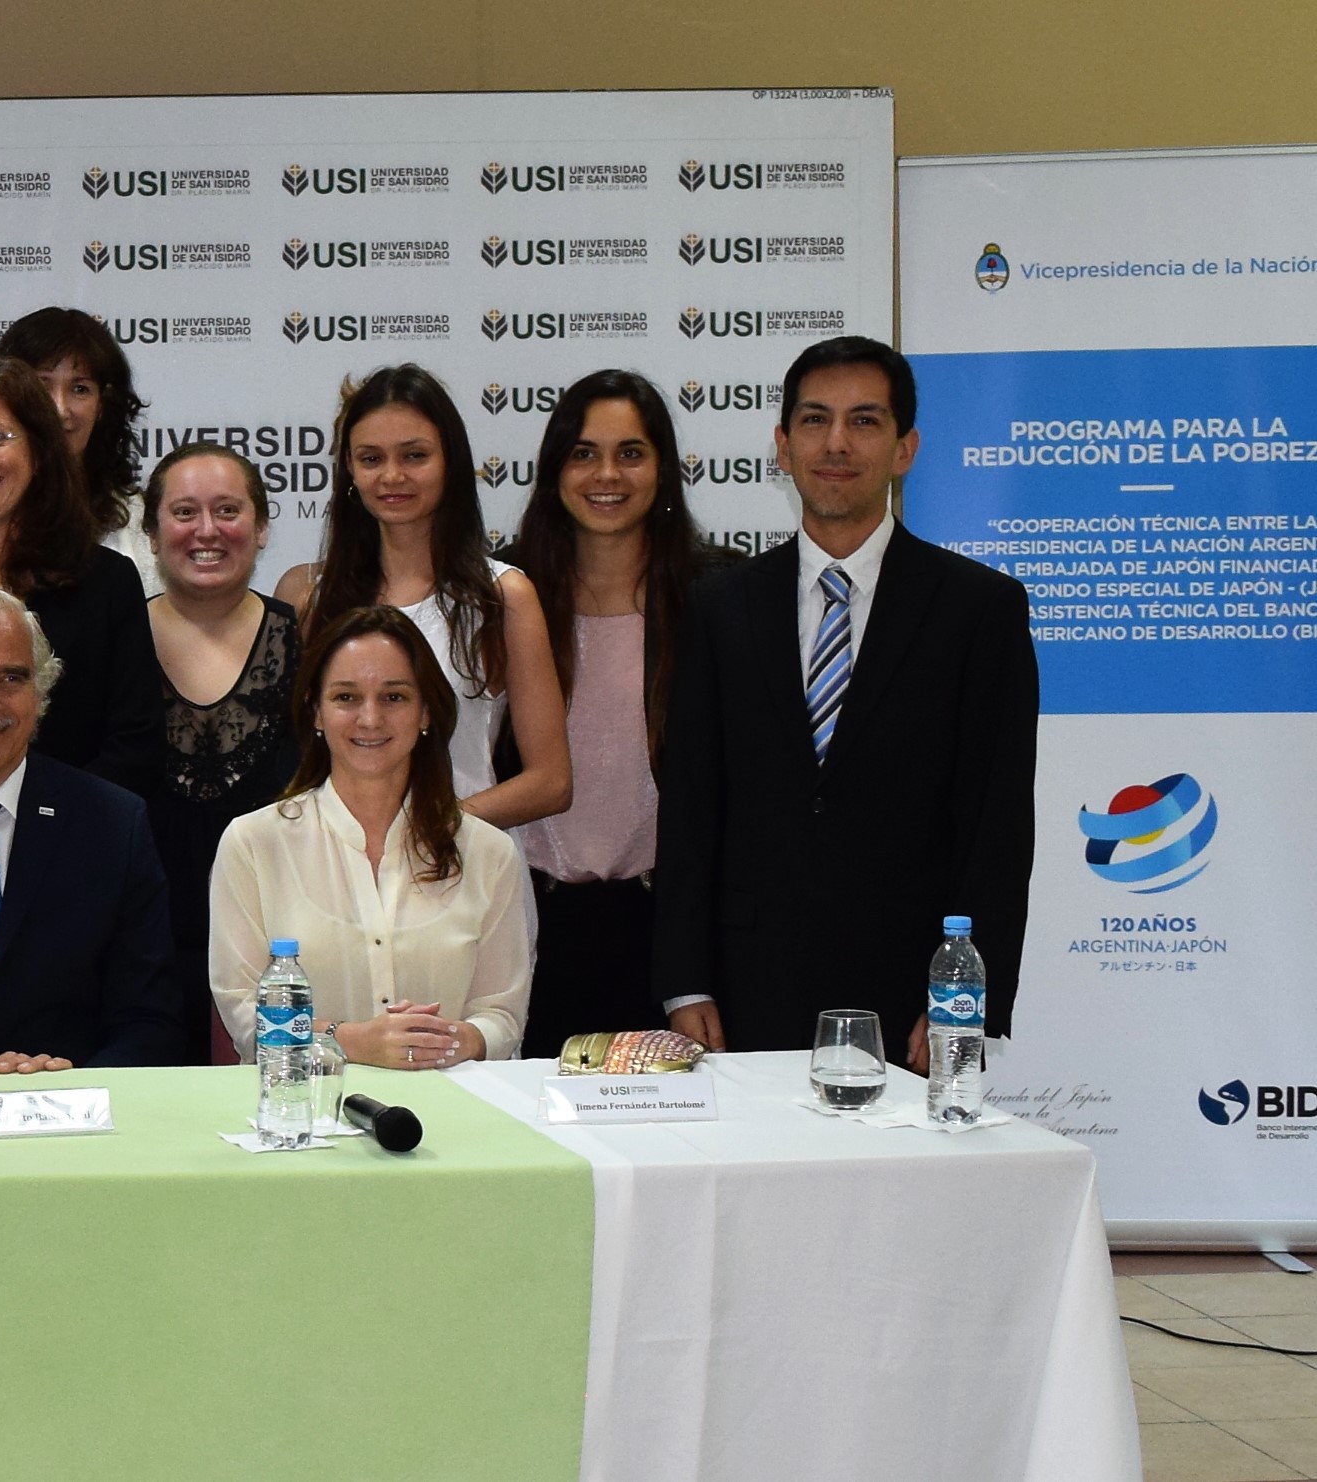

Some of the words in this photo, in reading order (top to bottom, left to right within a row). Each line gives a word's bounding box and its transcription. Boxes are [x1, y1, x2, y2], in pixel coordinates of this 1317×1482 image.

[752, 90, 766, 100] OP
[769, 90, 798, 99] 13224
[172, 170, 250, 180] UNIVERSIDAD
[371, 167, 449, 178] UNIVERSIDAD
[708, 164, 762, 190] USI
[766, 162, 844, 173] UNIVERSIDAD
[766, 172, 782, 182] DE
[784, 172, 807, 182] SAN
[810, 171, 845, 182] ISIDRO
[15, 182, 51, 192] ISIDRO
[114, 170, 167, 197] USI
[172, 179, 186, 189] DE
[189, 179, 212, 189] SAN
[215, 178, 250, 188] ISIDRO
[313, 168, 366, 195] USI
[371, 177, 386, 187] DE
[389, 177, 412, 187] SAN
[414, 176, 450, 186] ISIDRO
[512, 166, 565, 192] USI
[512, 240, 565, 266] USI
[570, 238, 648, 249] UNIVERSIDAD
[570, 248, 584, 258] DE
[587, 248, 610, 258] SAN
[613, 247, 648, 258] ISIDRO
[709, 238, 762, 264] USI
[114, 244, 168, 270] USI
[314, 242, 367, 268] USI
[1020, 260, 1185, 281] Vicepresidencia
[1191, 260, 1218, 275] de
[1224, 258, 1243, 274] la
[115, 318, 168, 344] USI
[314, 316, 367, 342] USI
[512, 313, 565, 339] USI
[709, 311, 762, 338] USI
[710, 384, 762, 411] USI
[1010, 420, 1165, 442] PROGRAMA
[1172, 418, 1244, 439] PARA
[1252, 417, 1288, 438] LA
[963, 440, 1120, 466] REDUCCIÓN
[1129, 444, 1164, 464] DE
[1171, 443, 1206, 464] LA
[710, 458, 762, 484] USI
[1140, 514, 1221, 532] TÉCNICA
[1226, 516, 1288, 531] ENTRE
[1294, 514, 1317, 530] LA
[1112, 540, 1137, 554] DE
[1142, 538, 1166, 553] LA
[1171, 536, 1244, 552] NACIÓN
[1016, 562, 1116, 577] EMBAJADA
[1122, 562, 1147, 575] DE
[1152, 557, 1215, 576] JAPÓN
[1096, 582, 1185, 598] ESPECIAL
[1189, 582, 1214, 596] DE
[1220, 578, 1283, 596] JAPÓN
[1138, 600, 1219, 618] TÉCNICA
[1225, 603, 1260, 618] DEL
[1132, 626, 1158, 640] DE
[1162, 625, 1287, 640] DESARROLLO
[1101, 918, 1134, 932] 120
[1138, 914, 1196, 932] AÑOS
[951, 1006, 974, 1014] aqua
[954, 998, 970, 1006] bon
[610, 1086, 630, 1095] USI
[1034, 1088, 1062, 1102] del
[1054, 1084, 1112, 1110] Japón
[576, 1103, 607, 1112] Jimena
[610, 1102, 656, 1110] Fernández
[659, 1100, 706, 1109] Bartolomé
[1036, 1104, 1050, 1118] la
[1257, 1086, 1317, 1118] BID
[1256, 1132, 1267, 1140] de
[1268, 1132, 1310, 1140] Desarrollo
